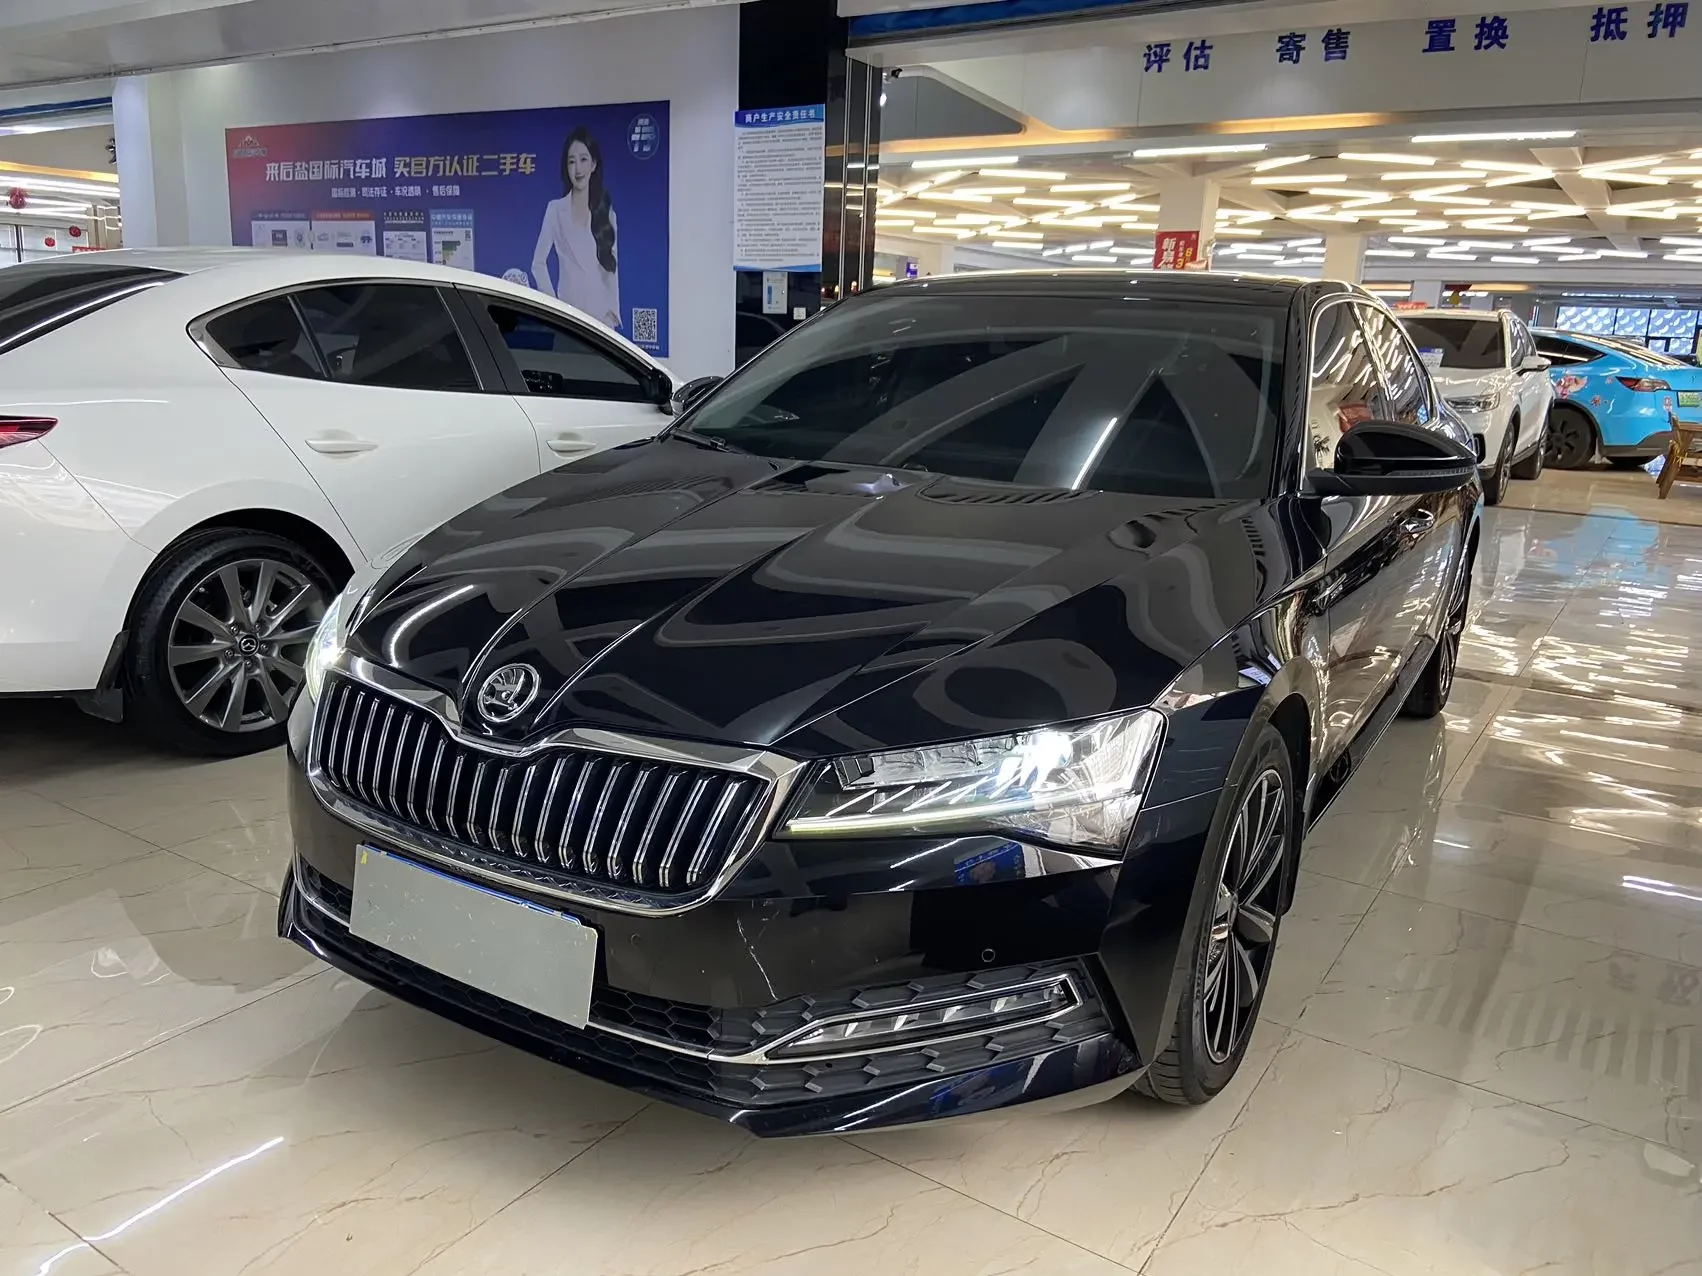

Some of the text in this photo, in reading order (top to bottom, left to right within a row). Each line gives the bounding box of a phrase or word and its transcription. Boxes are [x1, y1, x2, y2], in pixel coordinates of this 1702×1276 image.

[1143, 2, 1689, 73] 评估 寄售 置换 抵押
[745, 109, 816, 123] 商户生产安全责任书
[265, 152, 537, 182] 来后盐国际汽车城 买官方认证二手车
